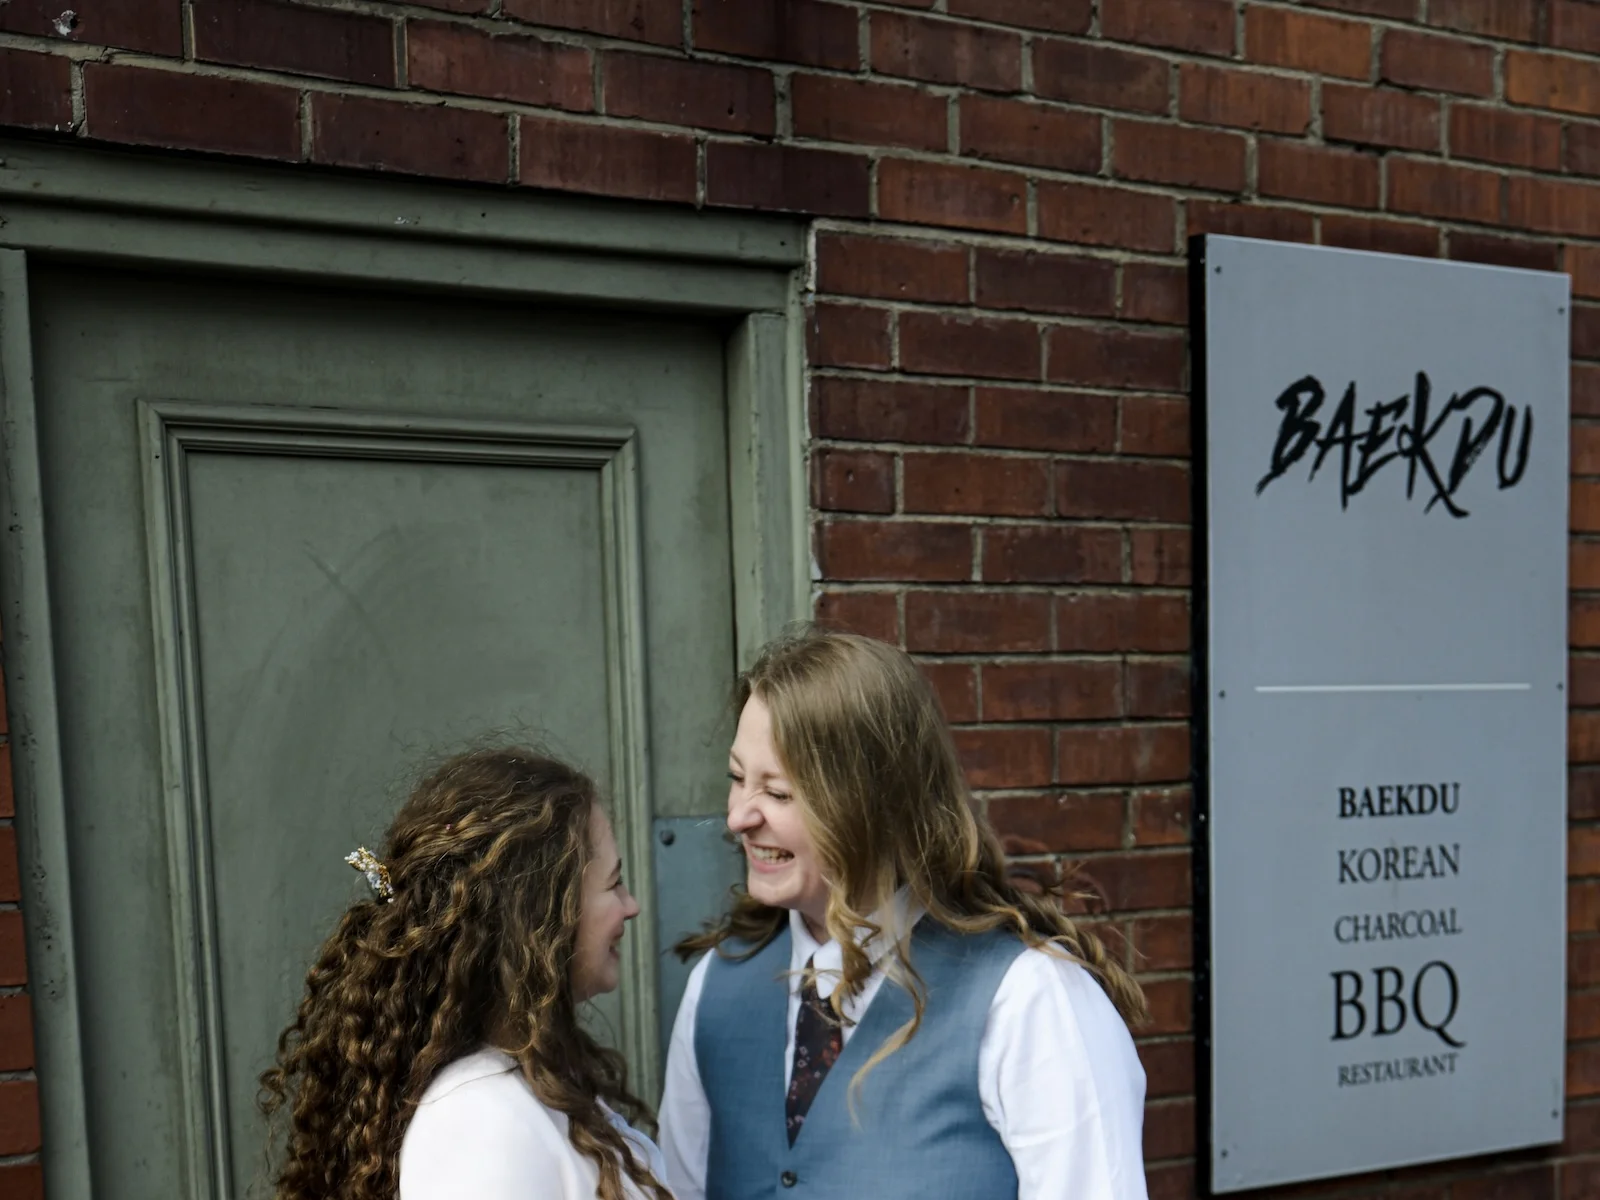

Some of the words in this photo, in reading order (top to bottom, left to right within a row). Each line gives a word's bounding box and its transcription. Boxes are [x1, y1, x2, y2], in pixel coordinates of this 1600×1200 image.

[1256, 370, 1532, 518] BAEKDU
[1337, 783, 1460, 818] BAEKDU
[1337, 844, 1460, 884] KOREAN
[1334, 908, 1462, 943] CHARCOAL
[1329, 960, 1467, 1048] BBQ
[1337, 1053, 1458, 1087] RESTAURANT
